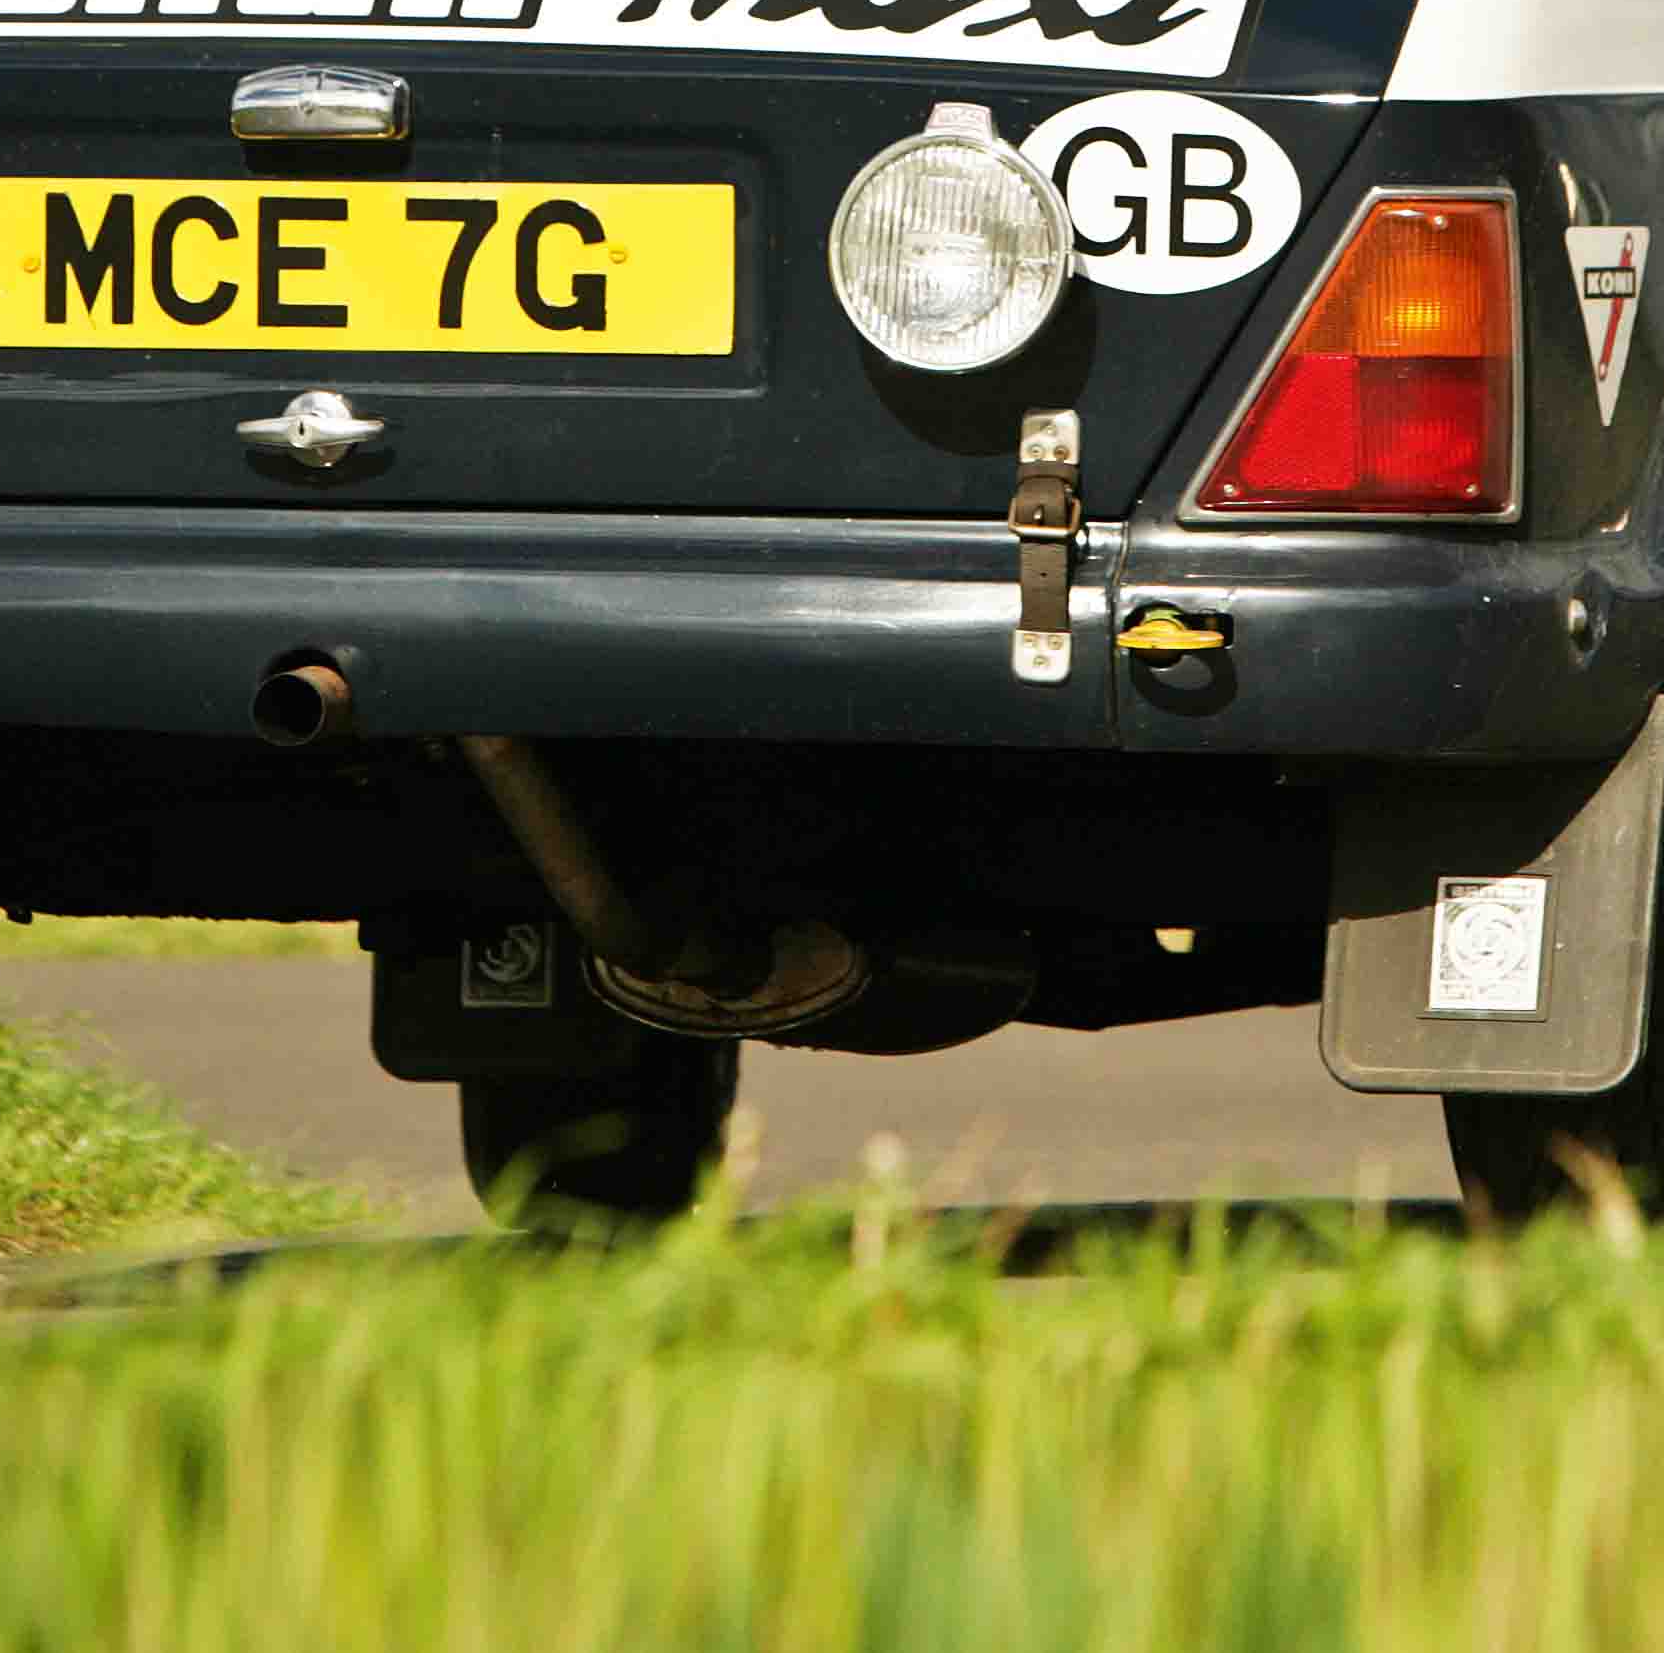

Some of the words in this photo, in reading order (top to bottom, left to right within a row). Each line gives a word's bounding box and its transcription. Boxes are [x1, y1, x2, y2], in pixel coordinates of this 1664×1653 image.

[1051, 126, 1254, 259] GB
[45, 193, 348, 328] MCE
[406, 199, 608, 331] 7G
[1587, 271, 1633, 295] KONI
